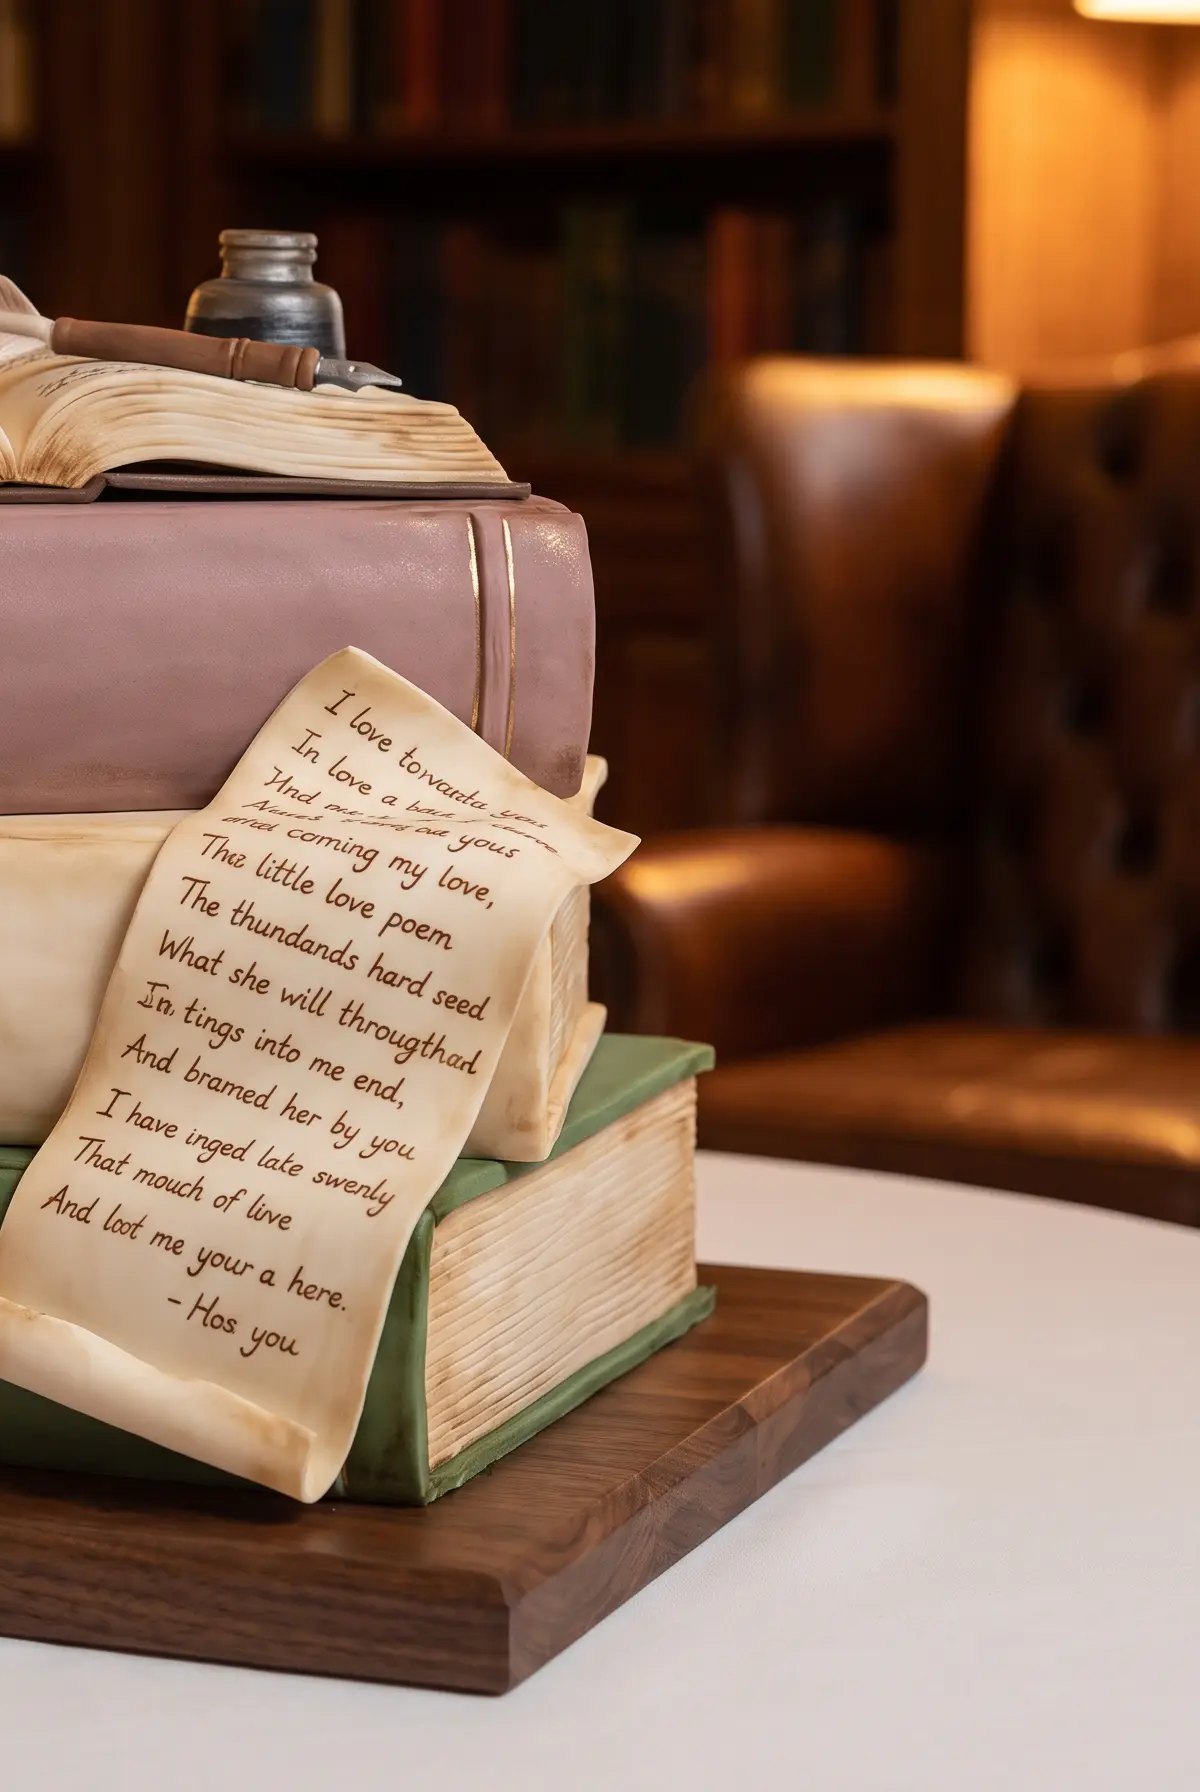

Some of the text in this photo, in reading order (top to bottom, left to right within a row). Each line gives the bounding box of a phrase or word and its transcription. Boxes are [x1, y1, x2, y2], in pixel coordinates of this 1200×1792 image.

[324, 690, 355, 716] I
[350, 707, 392, 752] love
[291, 729, 322, 764] In
[328, 756, 372, 795] love
[381, 796, 398, 806] a
[256, 853, 314, 894] little
[326, 878, 375, 919] love
[378, 912, 452, 950] poem
[287, 829, 493, 909] coming my love,
[159, 929, 225, 976] What
[229, 962, 270, 994] she
[281, 987, 332, 1016] will
[180, 876, 491, 1021] The thundands hard seed
[184, 998, 245, 1049] tings
[254, 1029, 300, 1063] into
[308, 1057, 345, 1081] me
[354, 1075, 405, 1109] end,
[96, 1088, 131, 1118] I
[125, 1101, 178, 1138] have
[121, 1034, 414, 1160] And bramed her by you
[74, 1136, 131, 1175] That
[213, 1189, 247, 1213] of
[40, 1185, 100, 1224] And
[150, 1232, 184, 1255] me
[187, 1247, 254, 1277] your
[259, 1270, 275, 1286] a
[287, 1266, 345, 1311] here.
[240, 1327, 299, 1357] you
